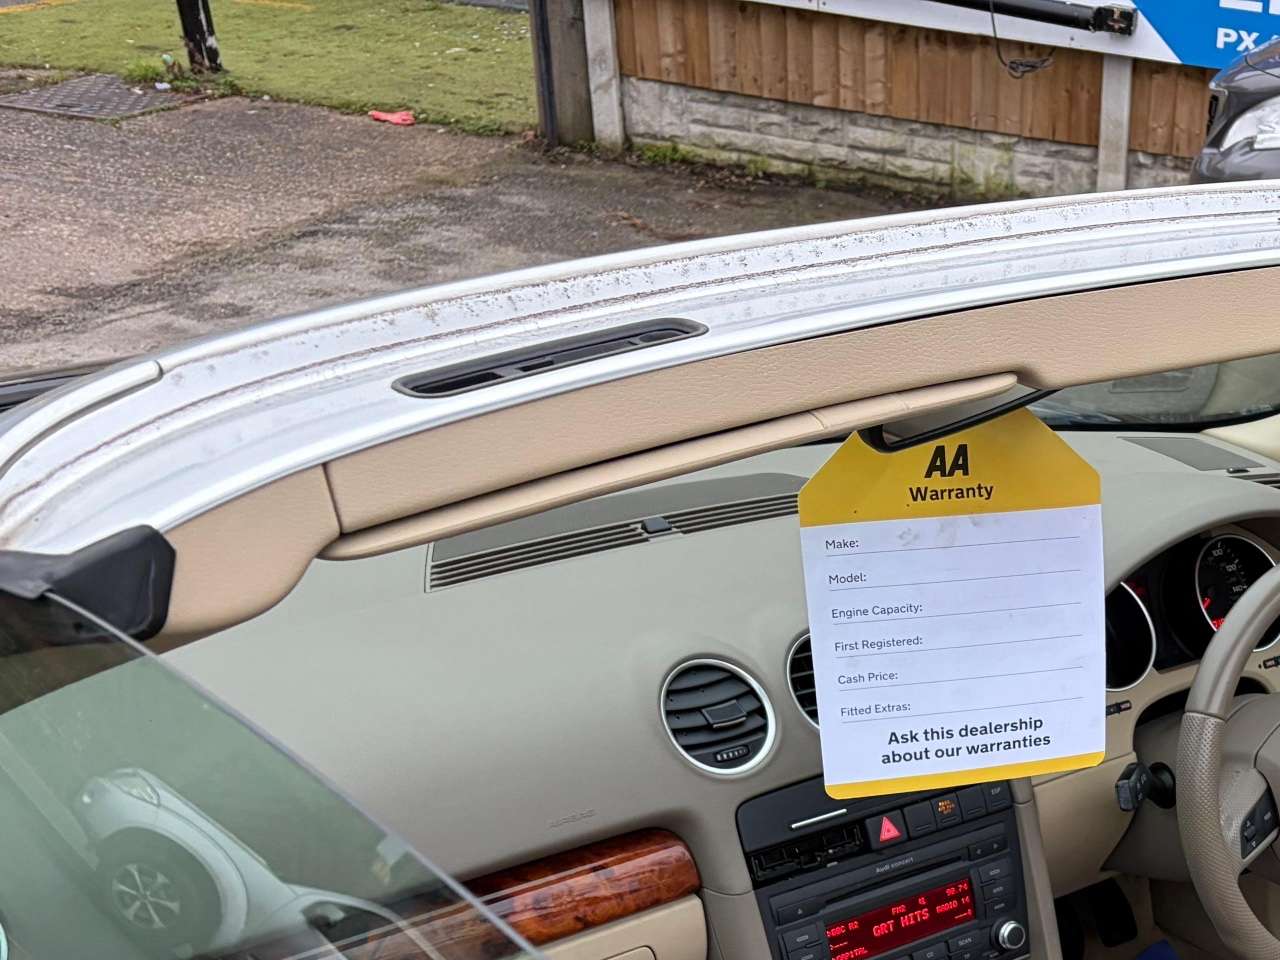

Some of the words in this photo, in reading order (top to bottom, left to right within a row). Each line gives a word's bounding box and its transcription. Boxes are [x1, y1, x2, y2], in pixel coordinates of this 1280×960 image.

[1216, 27, 1260, 51] PX
[924, 443, 969, 478] AA
[909, 483, 994, 502] Warranty
[825, 539, 859, 550] Make:
[828, 572, 867, 585] Model:
[831, 608, 869, 620] Engine
[872, 603, 923, 616] Capacity:
[835, 640, 860, 652] First
[861, 636, 923, 650] Registered:
[838, 674, 865, 685] Cash
[868, 672, 899, 682] Price:
[840, 705, 872, 717] Fitted
[874, 703, 911, 714] Extras:
[887, 730, 919, 745] Ask
[923, 726, 954, 742] this
[958, 716, 1044, 738] dealership
[881, 747, 930, 764] about
[934, 745, 962, 758] our
[965, 735, 1051, 755] warranties
[900, 908, 929, 928] HITS
